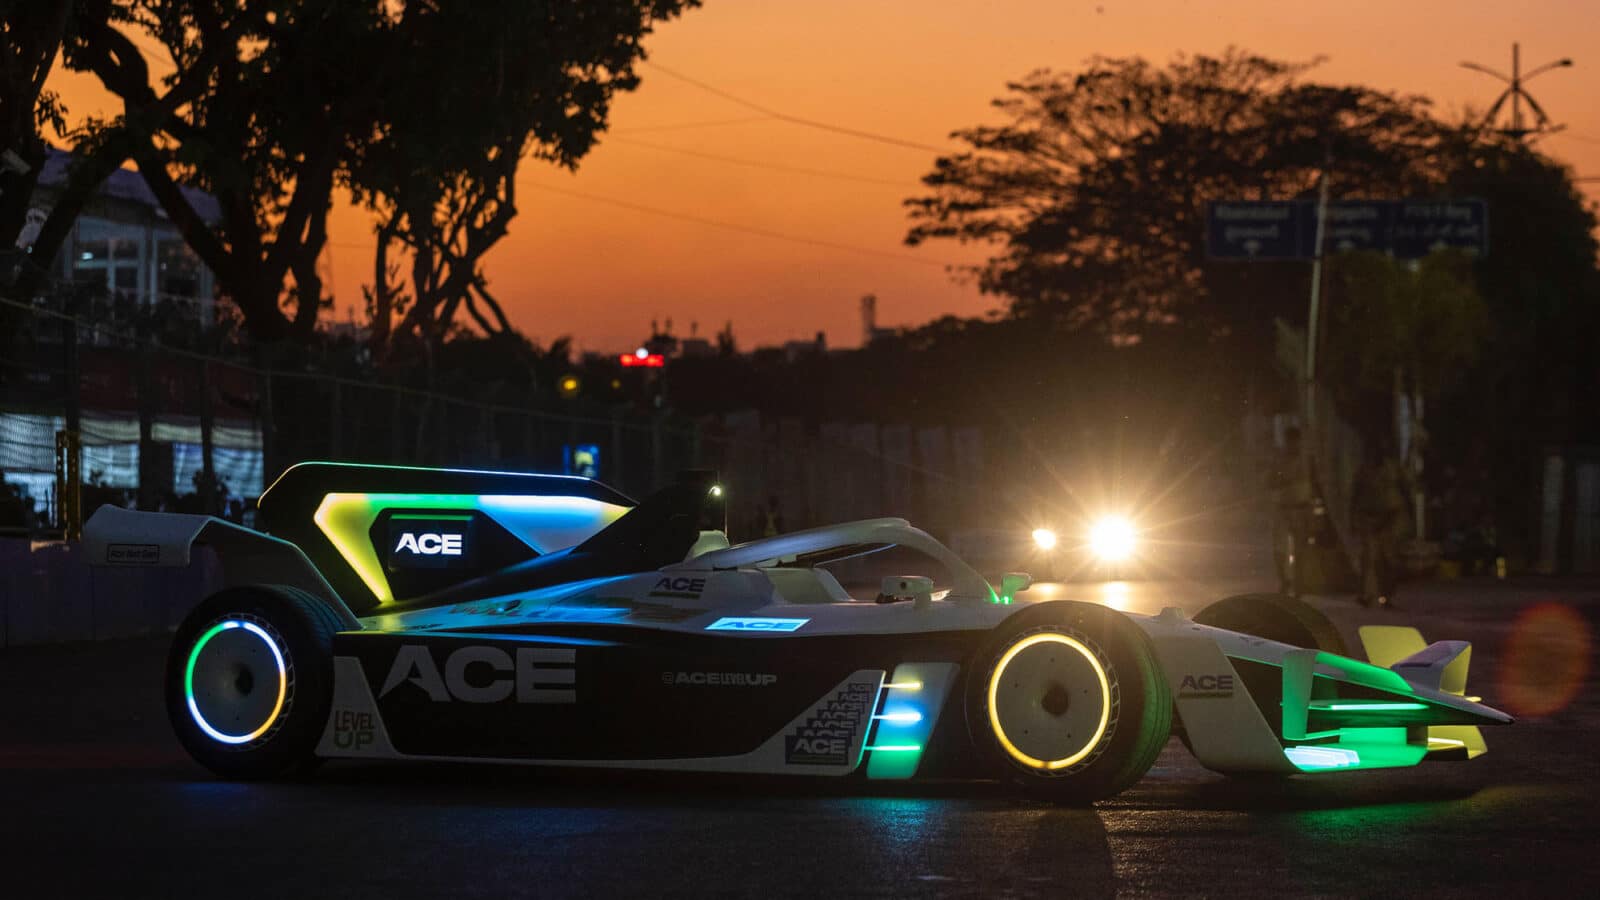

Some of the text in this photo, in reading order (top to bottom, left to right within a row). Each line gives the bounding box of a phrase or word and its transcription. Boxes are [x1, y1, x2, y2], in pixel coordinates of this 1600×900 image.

[394, 532, 463, 556] ACE
[654, 578, 705, 593] ACE
[718, 622, 800, 630] ACE
[378, 644, 577, 704] ACE
[1180, 675, 1232, 689] ACE
[335, 710, 374, 732] LEVEL
[334, 732, 374, 751] UP
[793, 738, 847, 754] ACE
